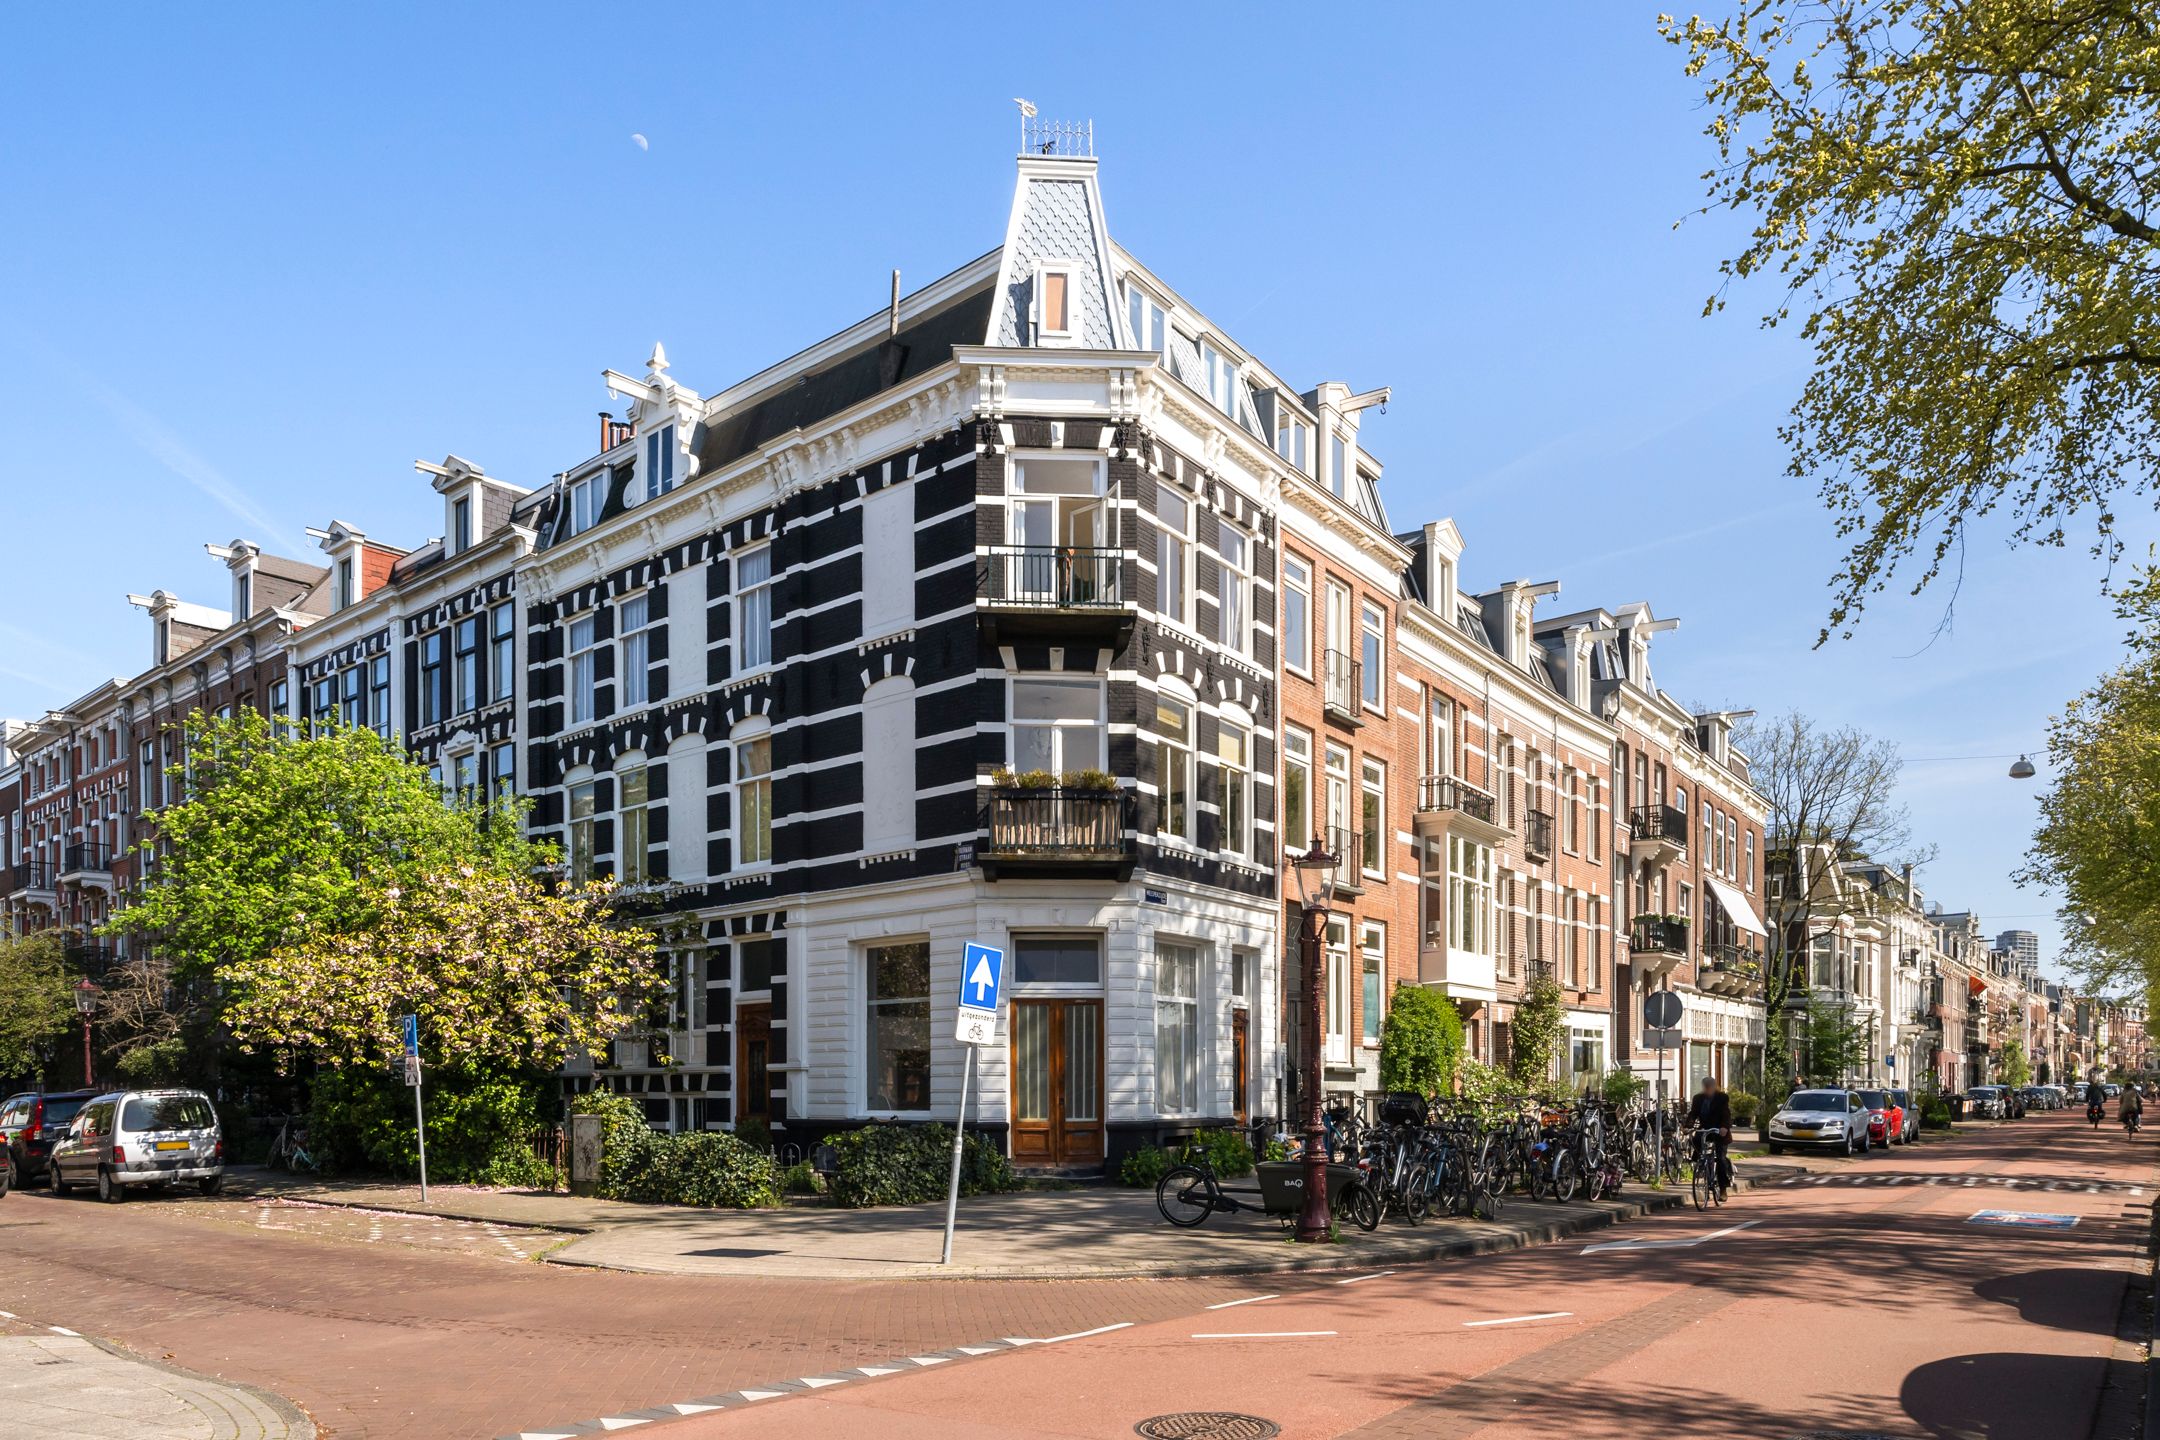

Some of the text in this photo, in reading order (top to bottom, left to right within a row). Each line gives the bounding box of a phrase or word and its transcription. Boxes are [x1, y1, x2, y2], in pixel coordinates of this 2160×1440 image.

[961, 1012, 995, 1022] uitgezonderd
[405, 1019, 411, 1039] P
[1284, 1179, 1303, 1188] BAQ
